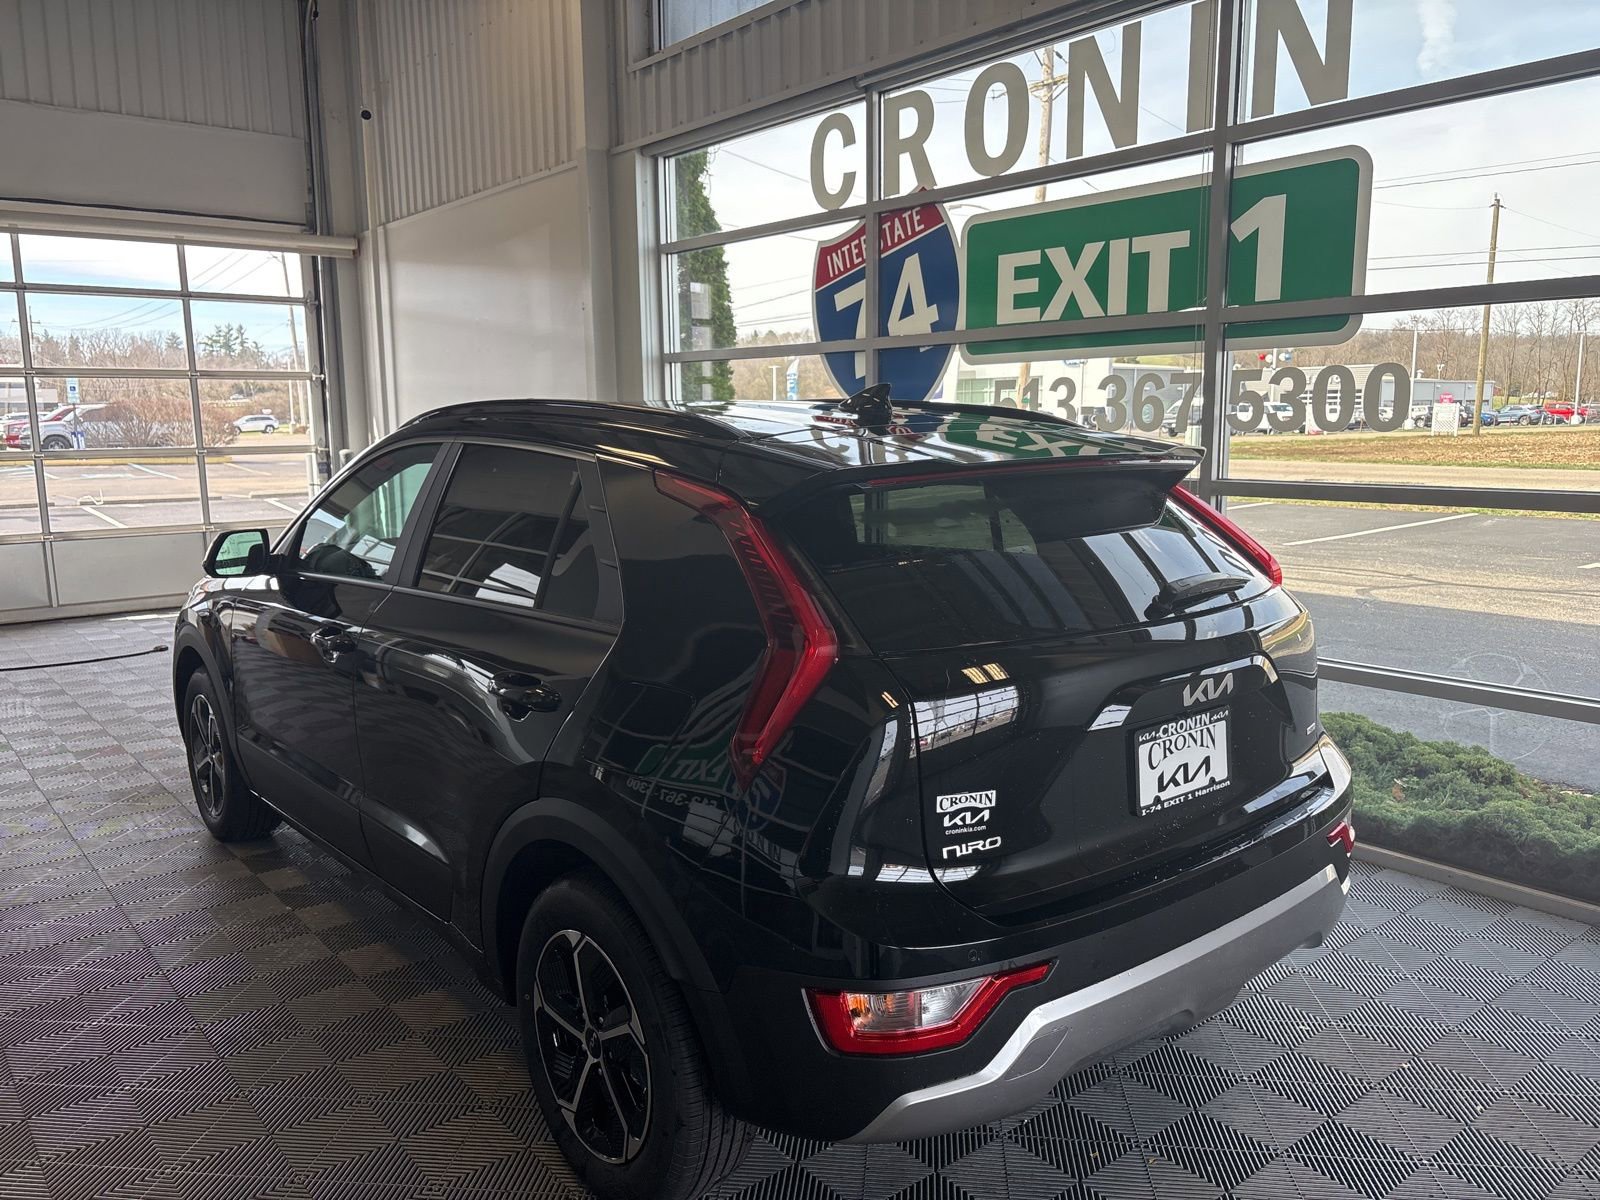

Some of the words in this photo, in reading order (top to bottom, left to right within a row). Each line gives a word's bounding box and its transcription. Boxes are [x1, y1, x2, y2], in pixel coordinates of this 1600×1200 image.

[809, 0, 1354, 211] CRONIN
[827, 207, 925, 278] INTETATE
[996, 229, 1191, 326] EXIT
[1230, 193, 1287, 302] 1
[833, 252, 940, 380] 74
[1183, 672, 1234, 707] KIA
[1159, 712, 1210, 738] CRONIN
[1147, 724, 1217, 771] CRONIN
[1157, 755, 1211, 794] KIA
[939, 792, 993, 811] CRONIN
[1141, 804, 1162, 817] I-74
[1163, 794, 1186, 809] EXIT
[1187, 791, 1194, 801] 1
[1195, 780, 1231, 798] Harrison
[943, 809, 990, 827] KIA
[945, 825, 987, 835] croninkia.com
